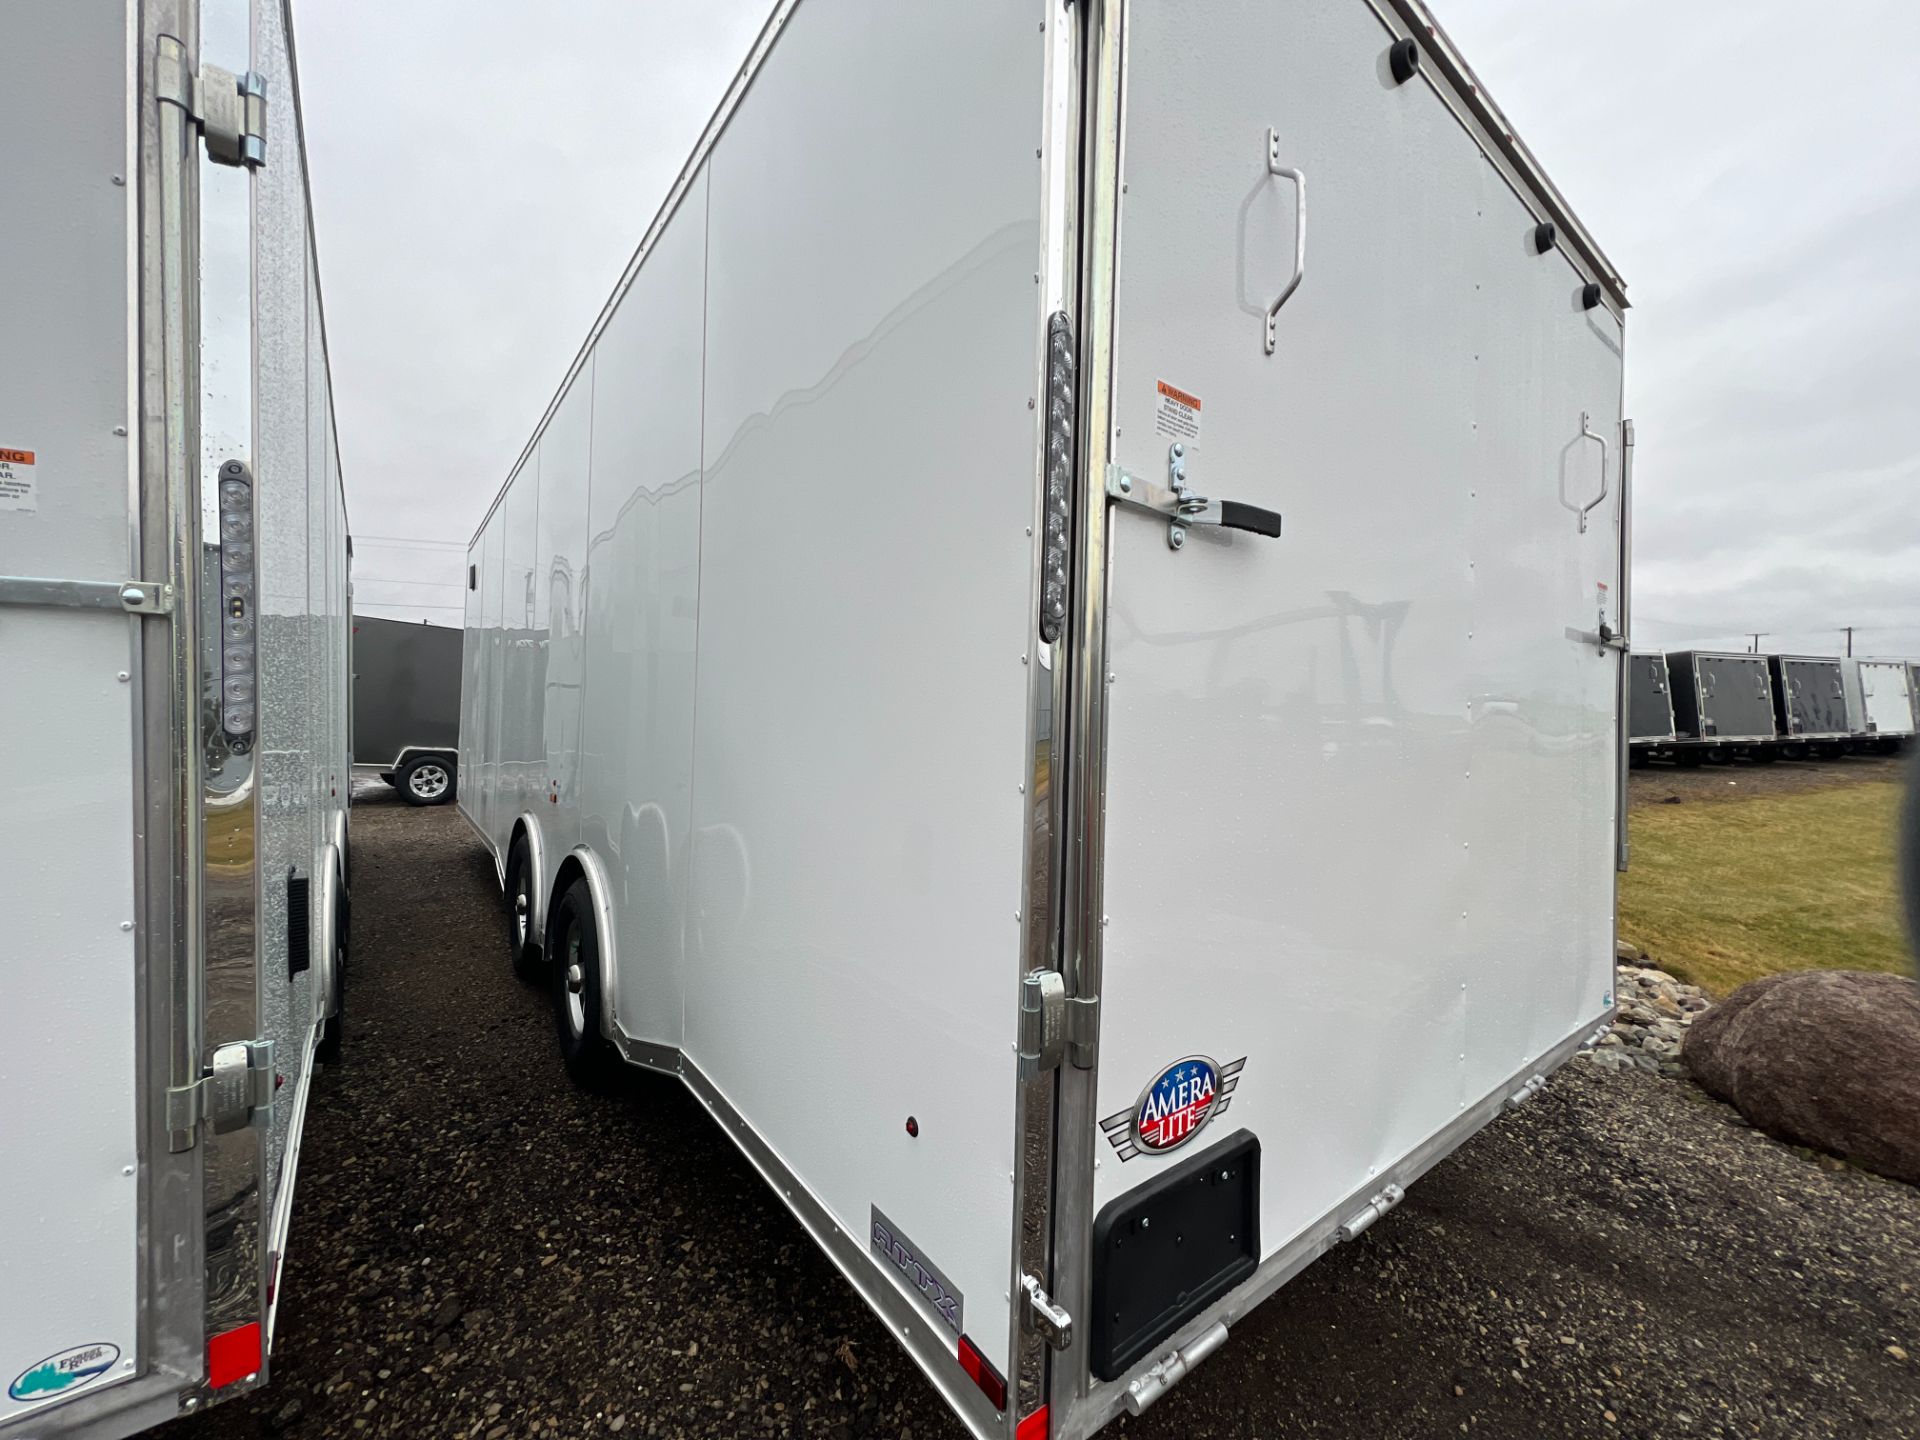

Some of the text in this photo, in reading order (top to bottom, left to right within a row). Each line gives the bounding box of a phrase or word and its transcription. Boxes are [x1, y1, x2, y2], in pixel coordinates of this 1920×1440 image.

[1168, 386, 1198, 409] WARNING
[1140, 1072, 1215, 1129] AMERA
[1158, 1106, 1197, 1146] LITE
